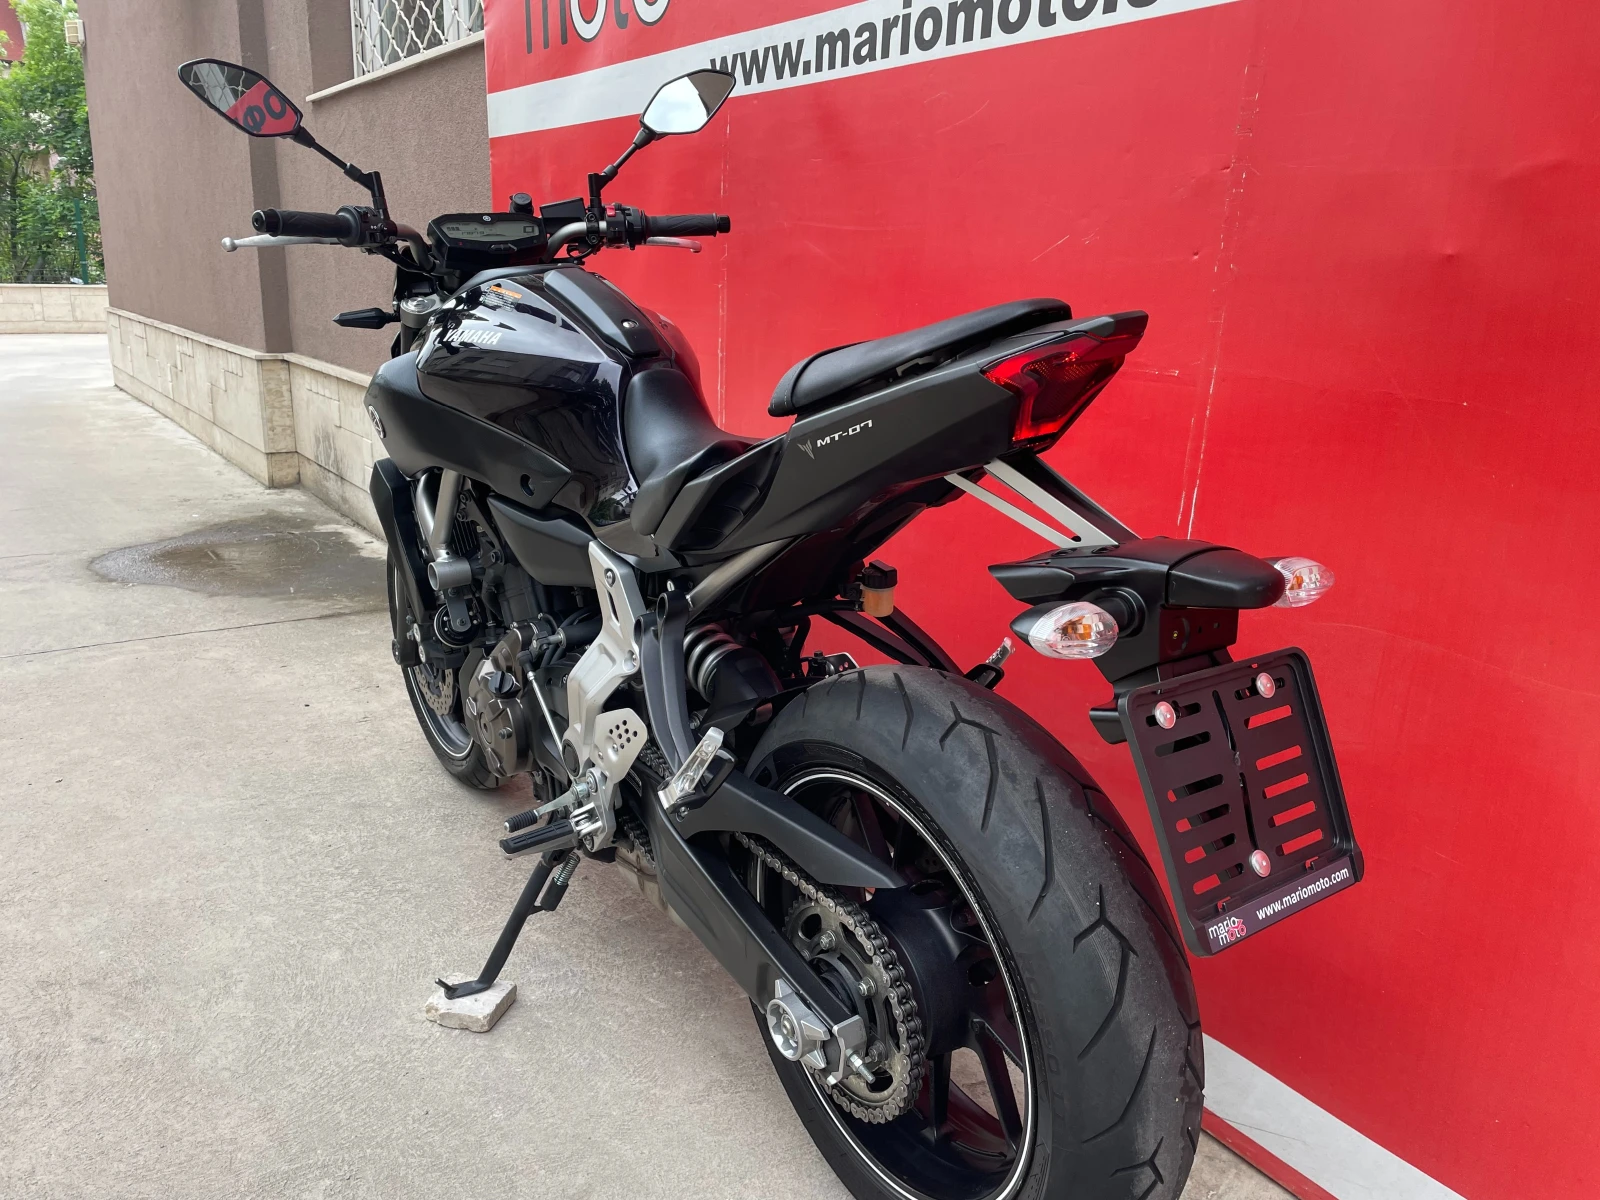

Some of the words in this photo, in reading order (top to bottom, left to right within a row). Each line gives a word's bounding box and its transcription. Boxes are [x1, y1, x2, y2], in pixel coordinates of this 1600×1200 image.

[443, 329, 502, 345] YAMAHA
[816, 419, 873, 448] MT-07
[1256, 867, 1350, 920] www.mariomoto.com
[1208, 916, 1237, 940] mario
